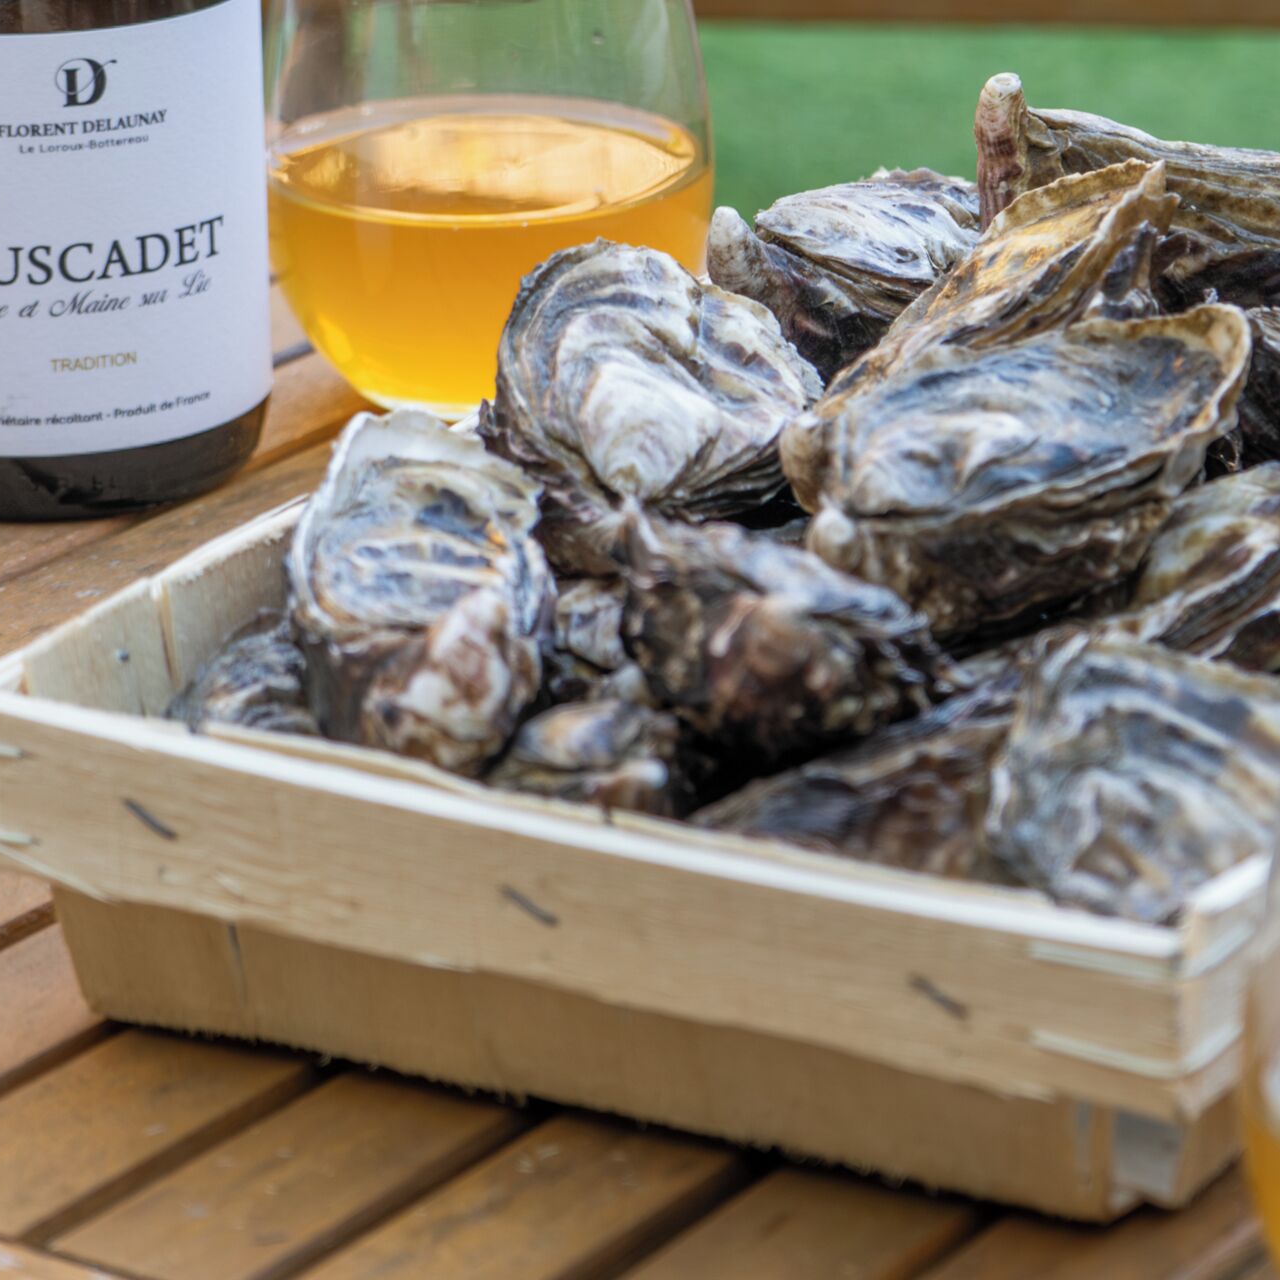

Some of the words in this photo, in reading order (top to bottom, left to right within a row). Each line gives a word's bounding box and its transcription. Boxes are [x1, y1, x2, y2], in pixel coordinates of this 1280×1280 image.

[82, 109, 168, 133] DELAUNAY
[19, 144, 35, 155] Le
[19, 299, 39, 319] et
[49, 290, 131, 318] Maine
[138, 287, 169, 308] sur
[50, 351, 138, 372] TRADITION
[114, 404, 157, 419] Produit
[160, 399, 173, 412] de
[176, 390, 211, 407] France
